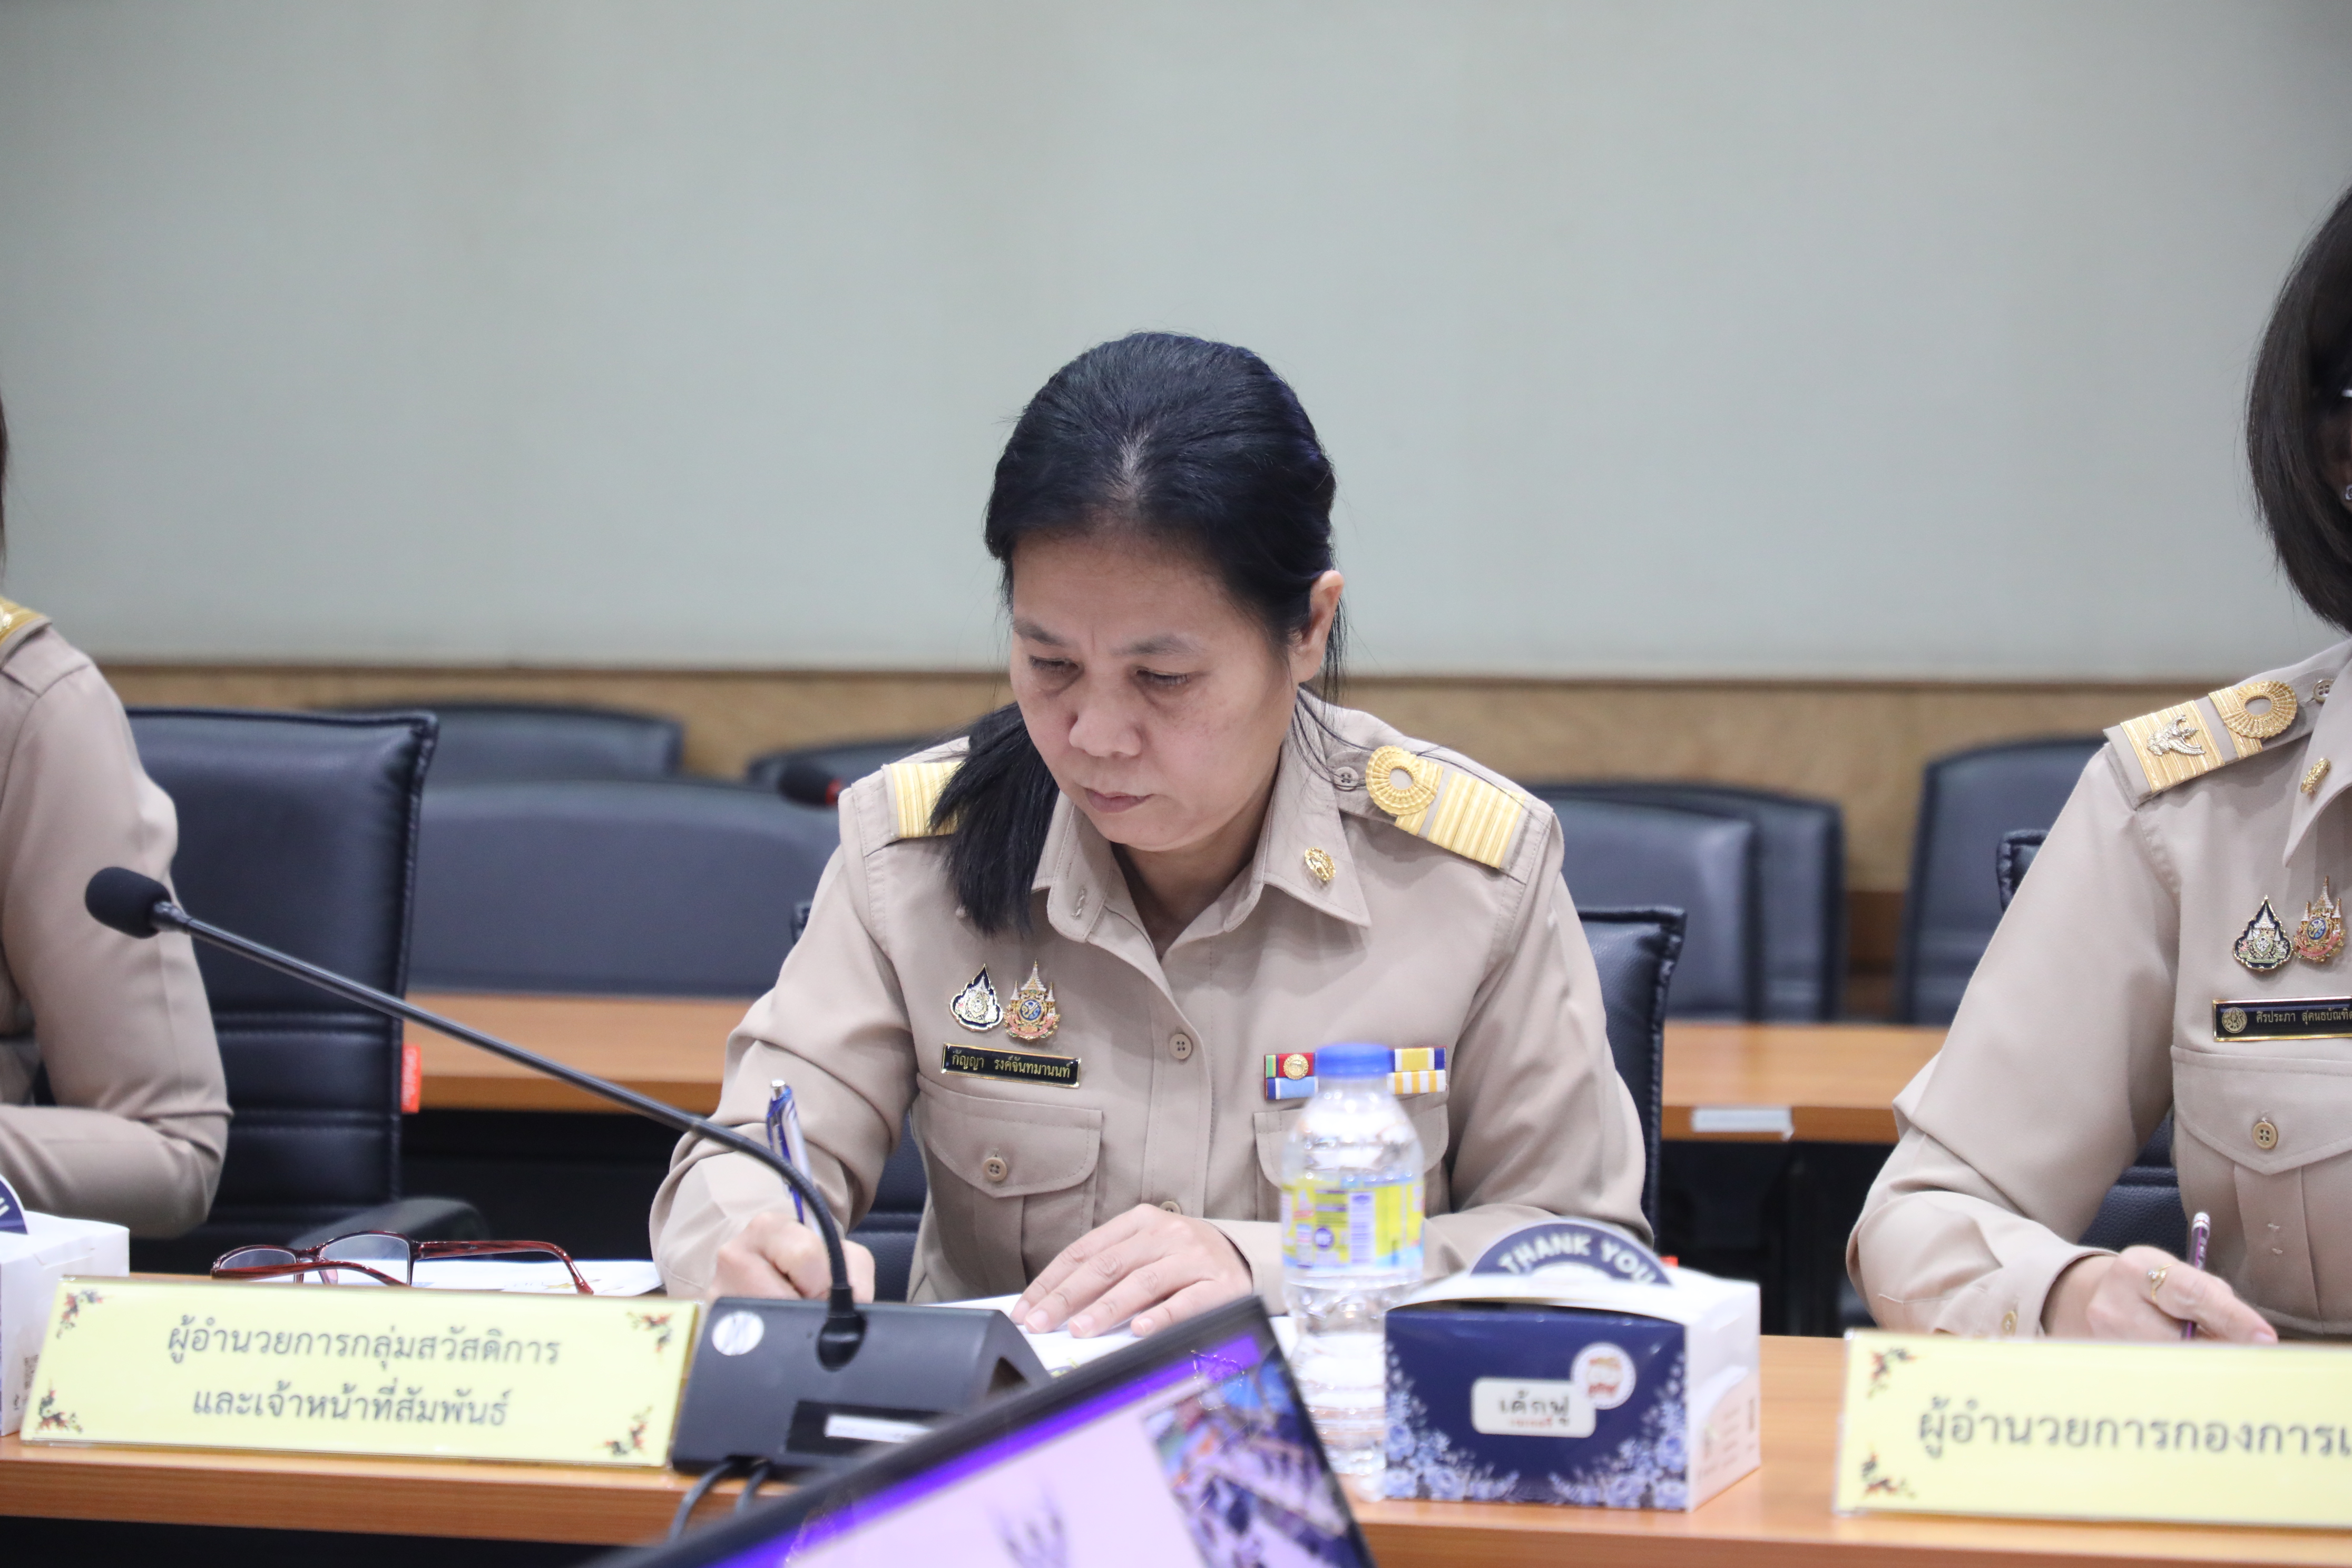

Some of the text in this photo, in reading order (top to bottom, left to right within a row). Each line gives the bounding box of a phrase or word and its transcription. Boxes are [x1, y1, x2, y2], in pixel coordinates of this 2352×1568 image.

[952, 1049, 984, 1071] กัญญา
[1497, 1232, 1658, 1284] THANK YOU
[168, 1315, 561, 1371] ผู้อำนวยการกลุ่มสวัสดิการ
[193, 1377, 512, 1426] และเจ้าหน้าที่สัมพันธ์
[1919, 1396, 2352, 1459] ผู้อำนวยการกองการเ
